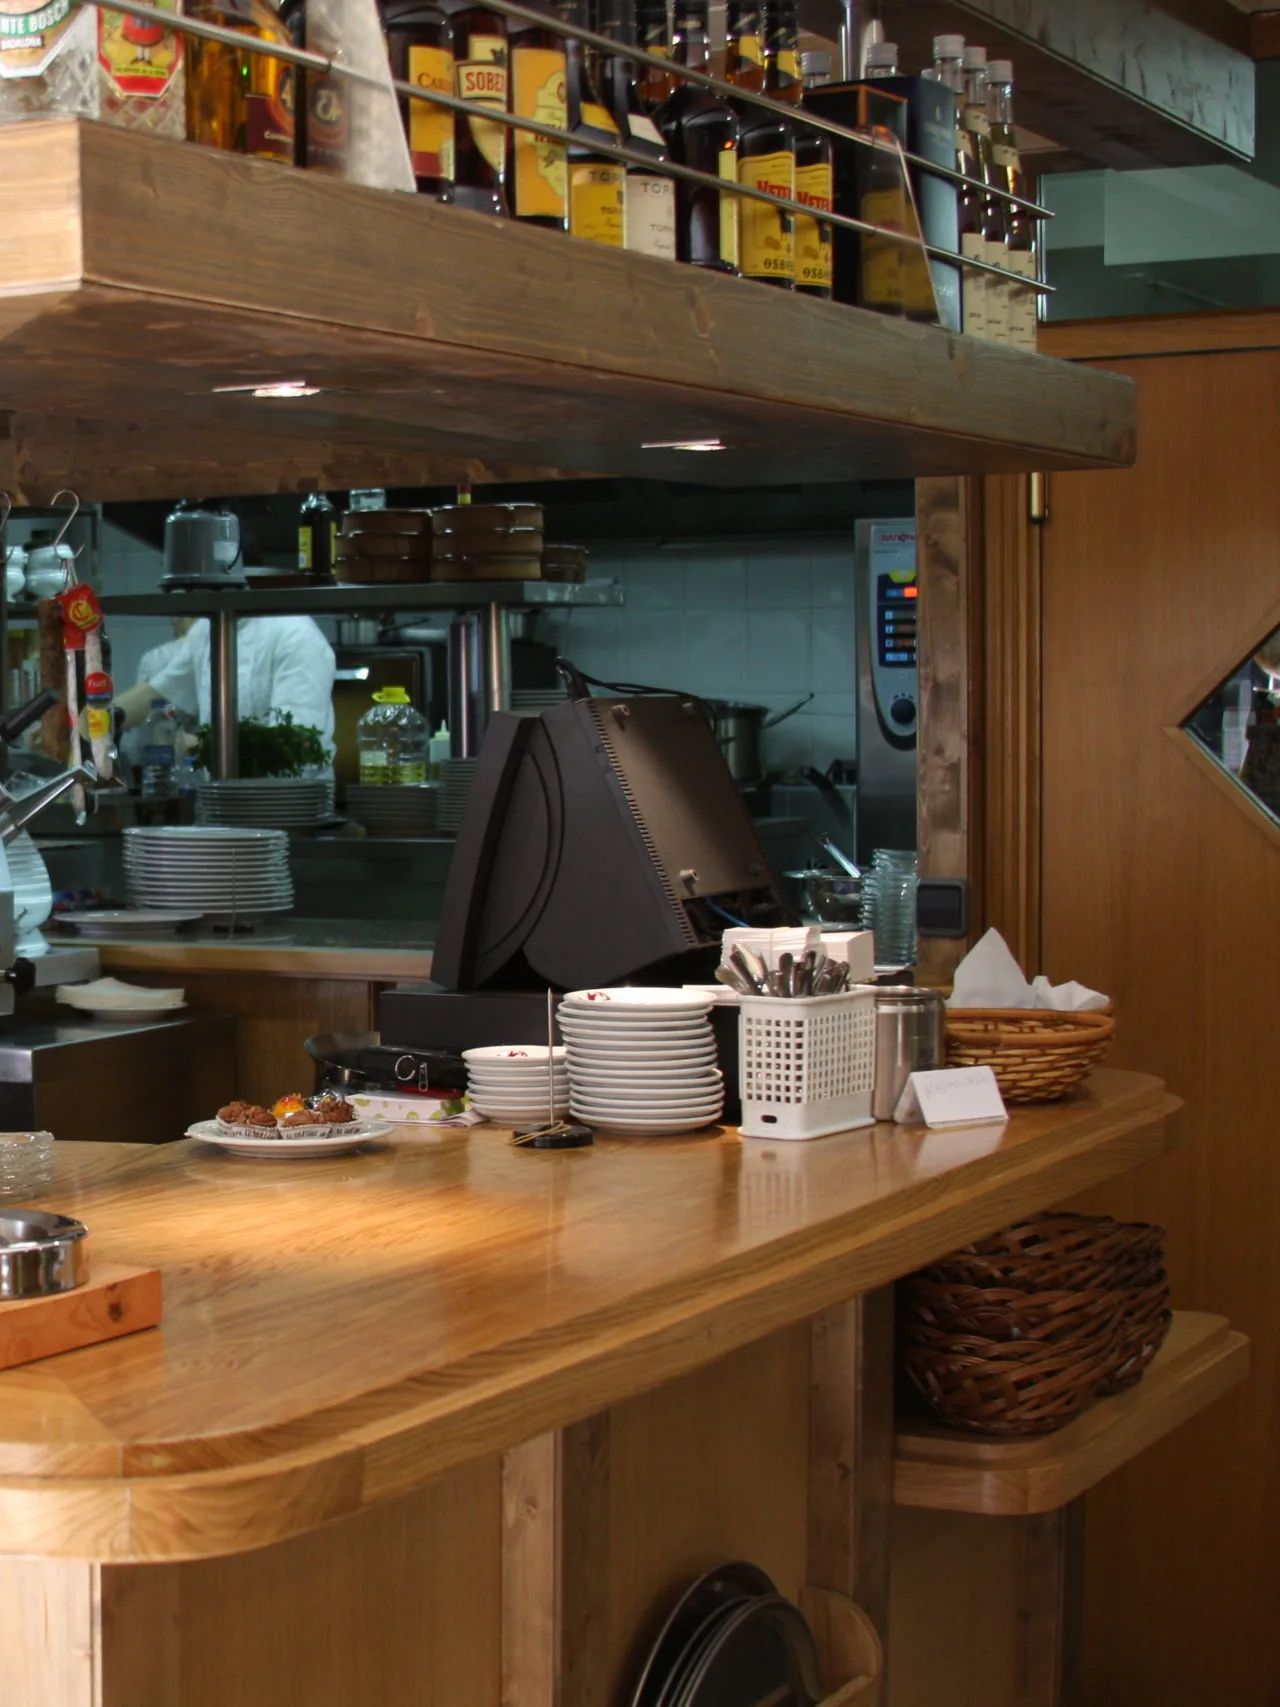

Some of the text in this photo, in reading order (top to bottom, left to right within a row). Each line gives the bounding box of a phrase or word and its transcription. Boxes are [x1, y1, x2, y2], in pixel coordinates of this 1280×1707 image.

[29, 1, 70, 33] BOSCH
[465, 71, 505, 93] SOBE
[881, 532, 916, 543] RATION
